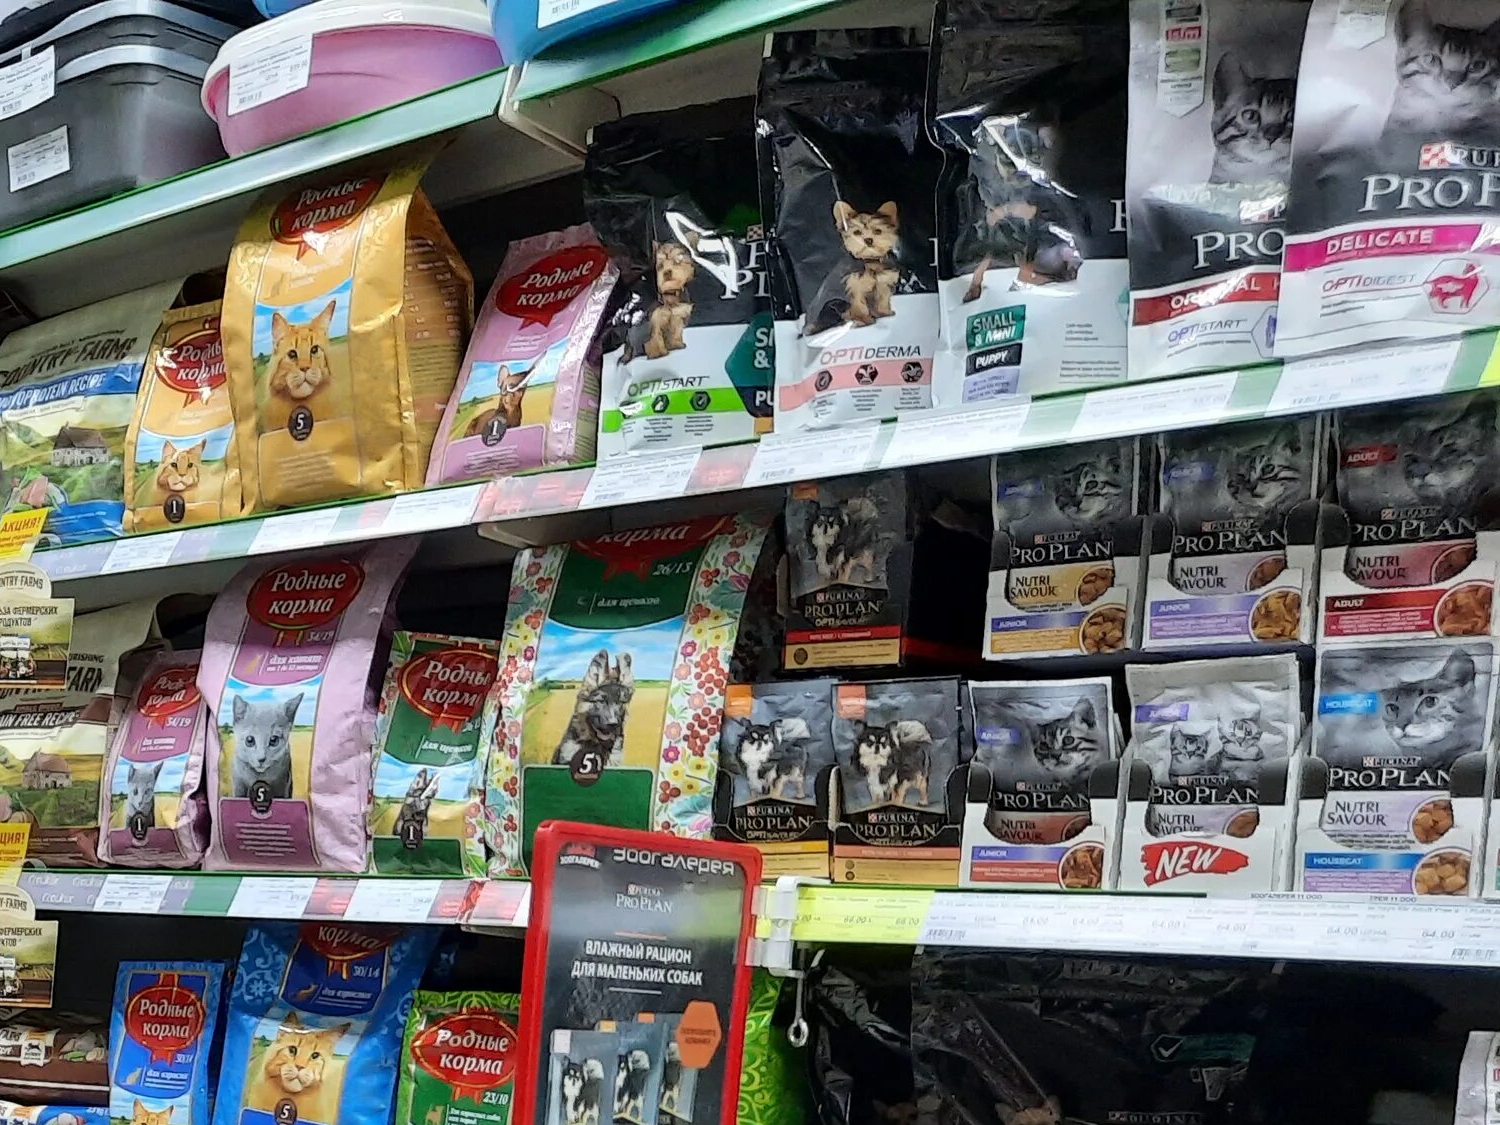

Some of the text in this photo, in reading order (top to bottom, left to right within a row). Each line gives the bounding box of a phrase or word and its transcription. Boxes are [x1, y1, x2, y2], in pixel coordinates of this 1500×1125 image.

[1357, 172, 1471, 213] PRO
[290, 197, 360, 233] корма
[1326, 228, 1435, 256] DELICATE
[521, 257, 596, 291] Родные
[1321, 271, 1418, 293] OPTIDIGEST
[515, 282, 582, 310] корма
[973, 312, 1017, 335] SMALL
[819, 343, 922, 367] OPTIDERMA
[974, 350, 1008, 369] PUPPY
[627, 375, 711, 398] OPTISTART
[293, 413, 306, 432] 5
[0, 515, 42, 536] АКЦИЯ!
[1352, 517, 1477, 542] PRO PLAN
[1047, 541, 1113, 562] PLAN
[1174, 531, 1286, 554] PRO PLAN
[1180, 565, 1219, 579] NUTRI
[1356, 556, 1400, 570] NUTRI
[270, 570, 348, 594] Родные
[1015, 575, 1051, 589] NUTRI
[1350, 568, 1406, 582] SAVOUR
[267, 596, 334, 616] корма
[804, 601, 882, 619] PRO PLAN
[1333, 598, 1364, 609] ADULT
[1328, 769, 1378, 788] PRO
[992, 791, 1091, 809] PRO PLAN
[1151, 785, 1260, 806] PRO PLAN
[1334, 800, 1380, 814] NUTRI
[735, 816, 811, 831] PRO PLAN
[1001, 819, 1036, 831] NUTRI
[1158, 813, 1195, 826] NUTRI
[1326, 812, 1388, 827] SAVOUR
[855, 824, 937, 838] PRO PLAN
[1154, 847, 1222, 882] NEW
[318, 925, 381, 950] корма
[585, 940, 692, 965] ВЛАЖНЫЙ РАЦИОН
[570, 960, 703, 986] ДЛЯ МАЛЕНЬКИХ СОБАК
[139, 1000, 196, 1019] Родные
[142, 1020, 191, 1040] корма
[436, 1028, 510, 1053] Родные
[439, 1051, 503, 1076] корма
[280, 1103, 291, 1120] 5
